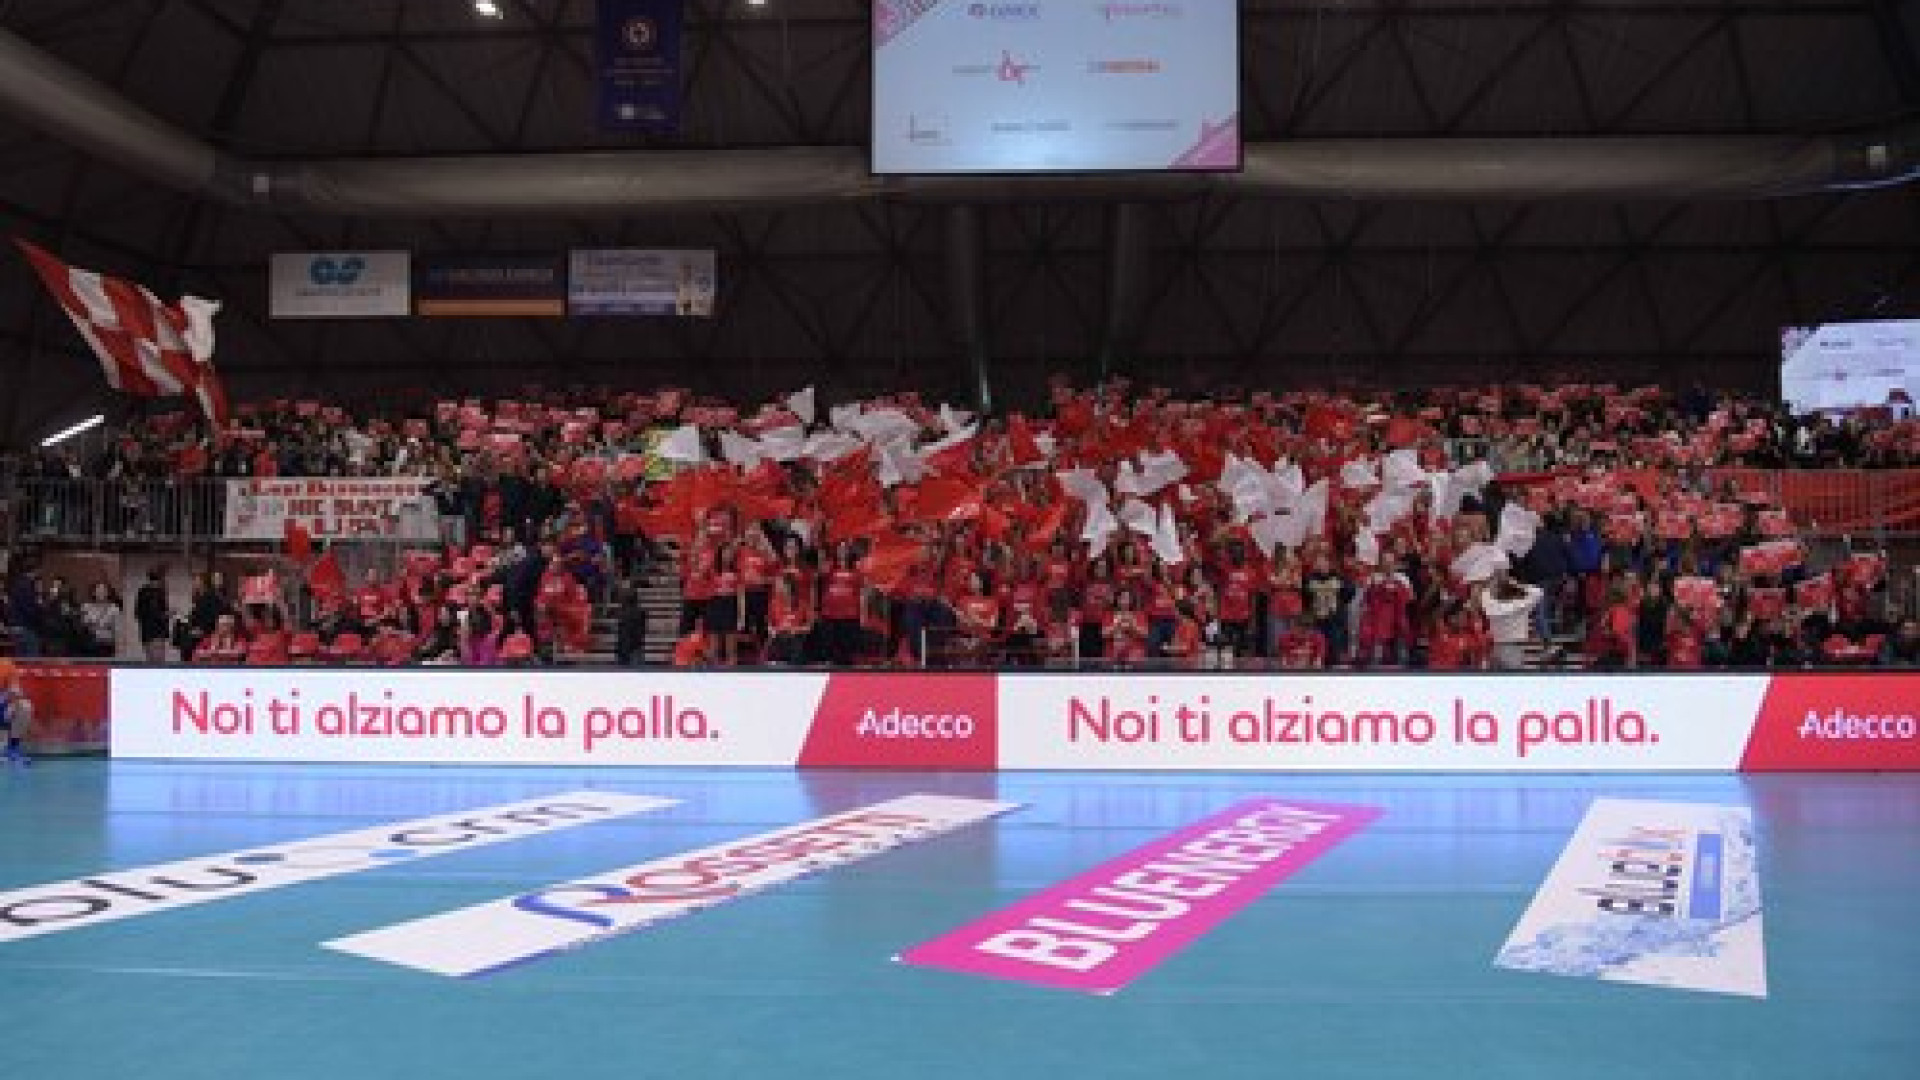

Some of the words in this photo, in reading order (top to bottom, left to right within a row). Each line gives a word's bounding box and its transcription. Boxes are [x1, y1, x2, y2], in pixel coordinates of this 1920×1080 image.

[172, 688, 253, 735] Noi
[269, 688, 300, 735] ti
[315, 691, 507, 738] alziamo
[523, 694, 568, 739] la
[583, 694, 719, 753] palla.
[857, 706, 976, 739] Adecco
[1068, 696, 1160, 743] Noi
[1175, 696, 1210, 743] ti
[1229, 698, 1436, 743] alziamo
[1454, 700, 1499, 743] la
[1517, 699, 1660, 758] palla.
[1797, 707, 1917, 739] Adecco
[975, 803, 1342, 972] BLUENERGY
